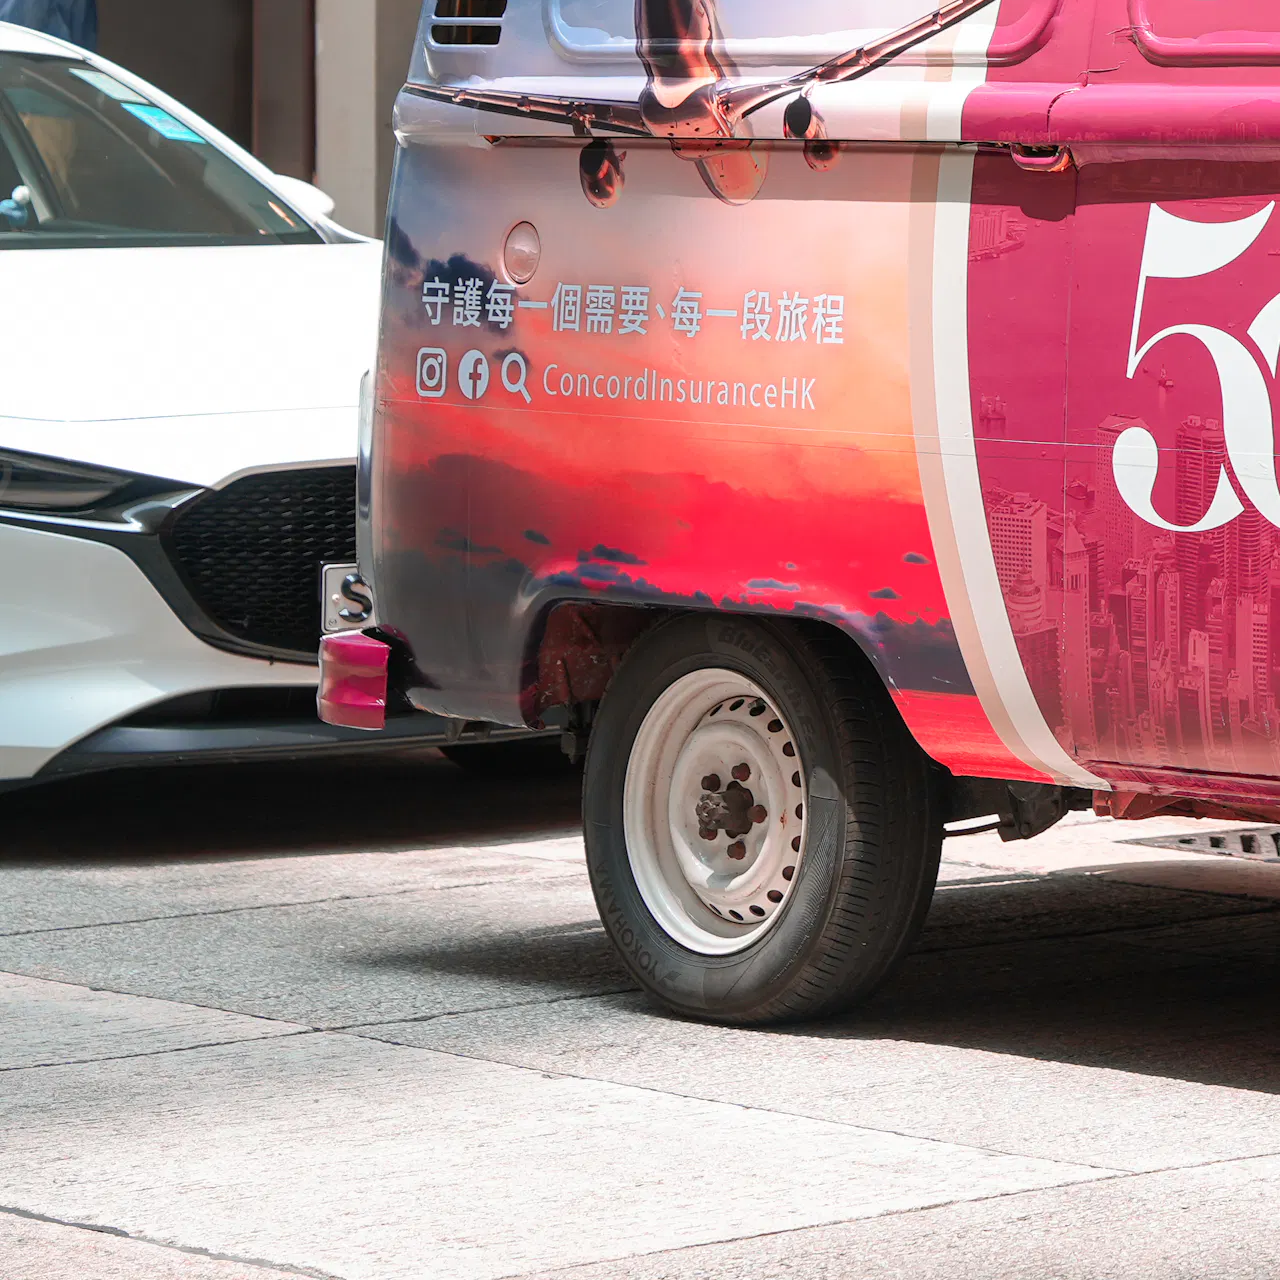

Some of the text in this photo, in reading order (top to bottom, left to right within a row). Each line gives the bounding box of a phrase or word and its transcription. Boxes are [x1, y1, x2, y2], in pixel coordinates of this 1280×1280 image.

[421, 277, 846, 345] 守護每一個需要、每一段旅程
[542, 363, 817, 410] ConcordInsuranceHK
